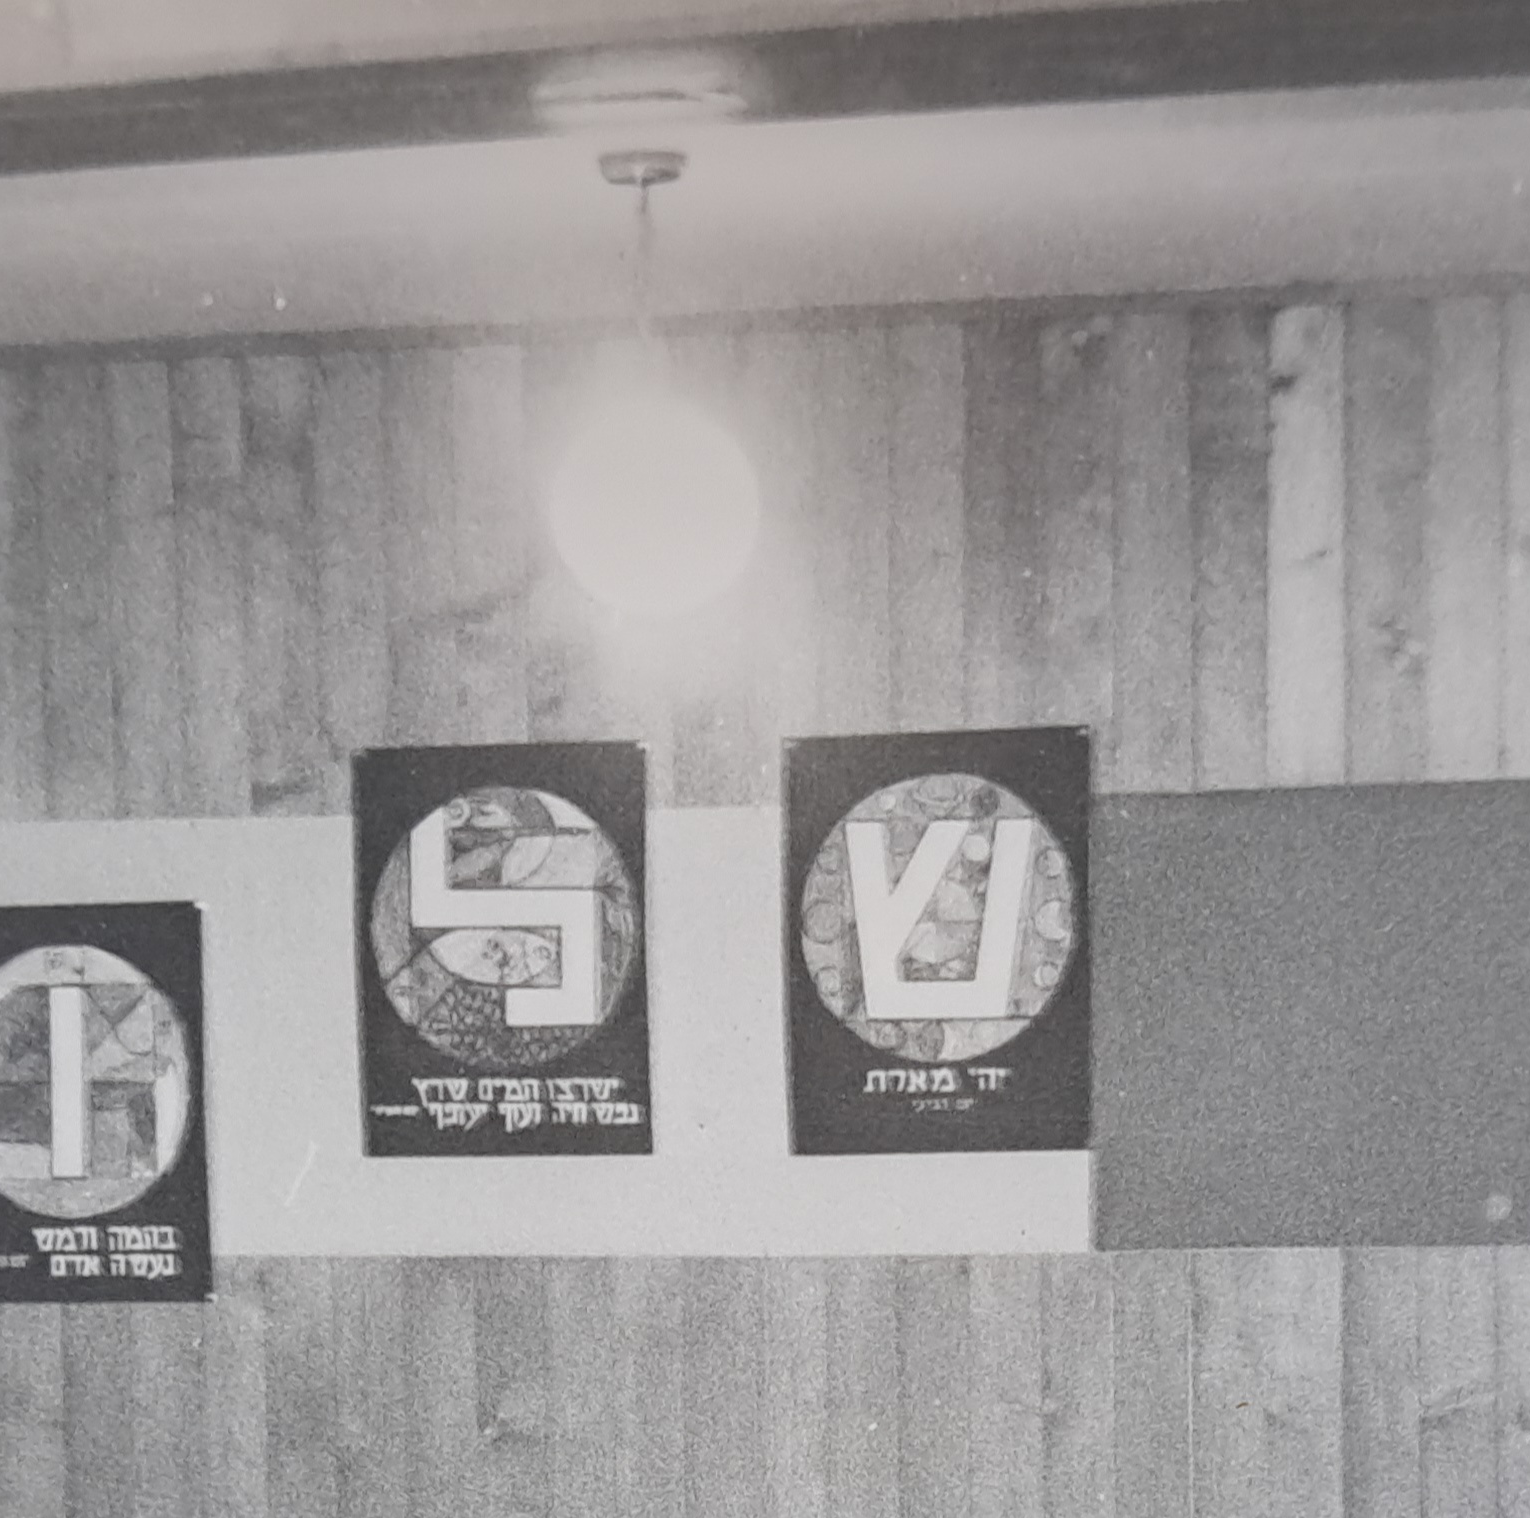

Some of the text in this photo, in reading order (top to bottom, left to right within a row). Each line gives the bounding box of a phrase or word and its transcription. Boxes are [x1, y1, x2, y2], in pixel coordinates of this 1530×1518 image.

[409, 807, 597, 1026] ל
[845, 819, 1034, 1018] ש
[411, 1076, 621, 1107] ישרצו המים שרץ
[863, 1066, 957, 1093] מארת
[551, 1102, 589, 1124] חיה
[590, 1102, 643, 1125] נפש
[31, 1225, 178, 1252] בהמה ורמש
[50, 1253, 178, 1281] נעשה אדם
